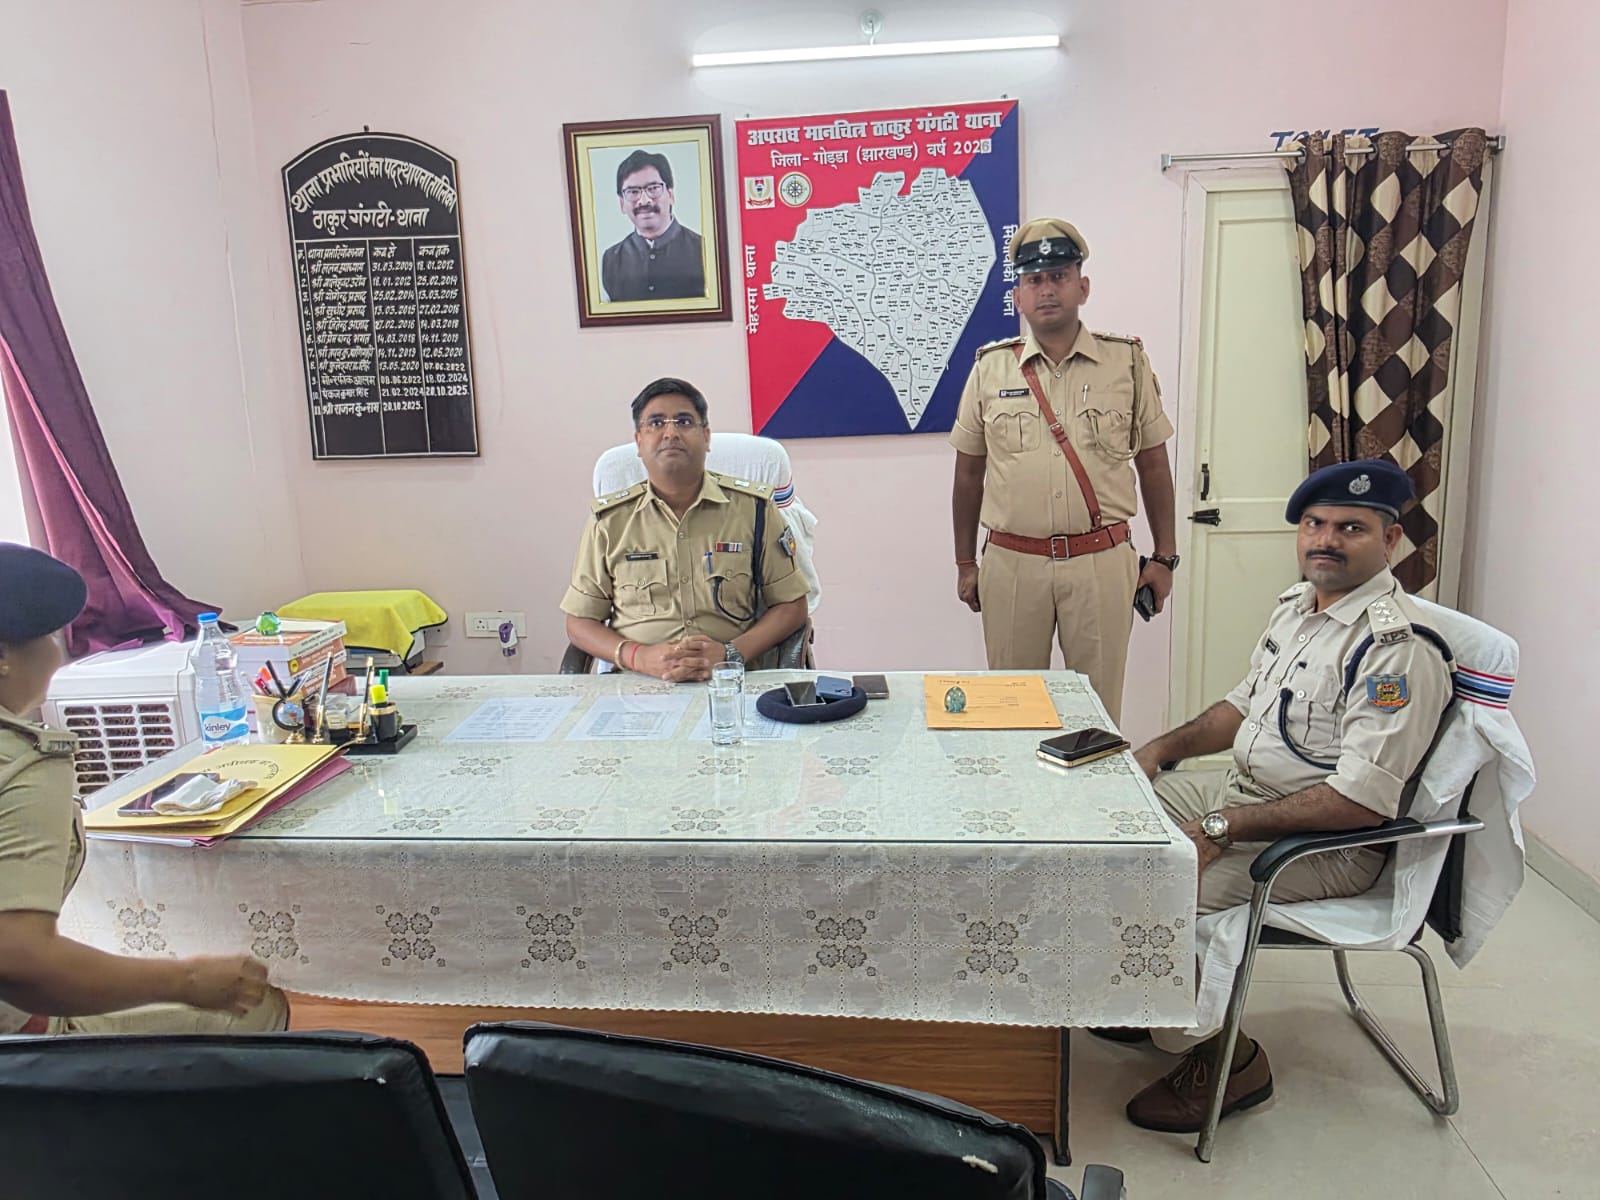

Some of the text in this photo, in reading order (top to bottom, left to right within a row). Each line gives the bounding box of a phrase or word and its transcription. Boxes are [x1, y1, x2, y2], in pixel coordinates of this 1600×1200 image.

[748, 127, 800, 146] अपराध
[870, 119, 912, 140] ठाकुर
[916, 112, 959, 132] गंगटी
[965, 112, 1002, 129] थाना
[813, 146, 848, 169] गोड्डा
[856, 140, 918, 165] (झारखण्ड)
[926, 137, 946, 156] वर्ष
[953, 138, 992, 154] 2026
[291, 176, 324, 212] थाना
[318, 150, 369, 194] प्रभारियों
[368, 157, 384, 178] का
[312, 210, 349, 235] ठाकुर
[311, 260, 322, 275] श्री
[312, 275, 323, 288] श्री
[313, 290, 324, 301] श्री
[745, 245, 758, 334] मेहरमा थाना
[314, 302, 326, 317] श्री
[316, 319, 328, 332] श्री
[317, 332, 327, 344] श्री
[308, 348, 314, 358] 7.
[318, 346, 328, 358] श्री
[319, 358, 327, 370] श्री
[323, 403, 333, 415] श्री
